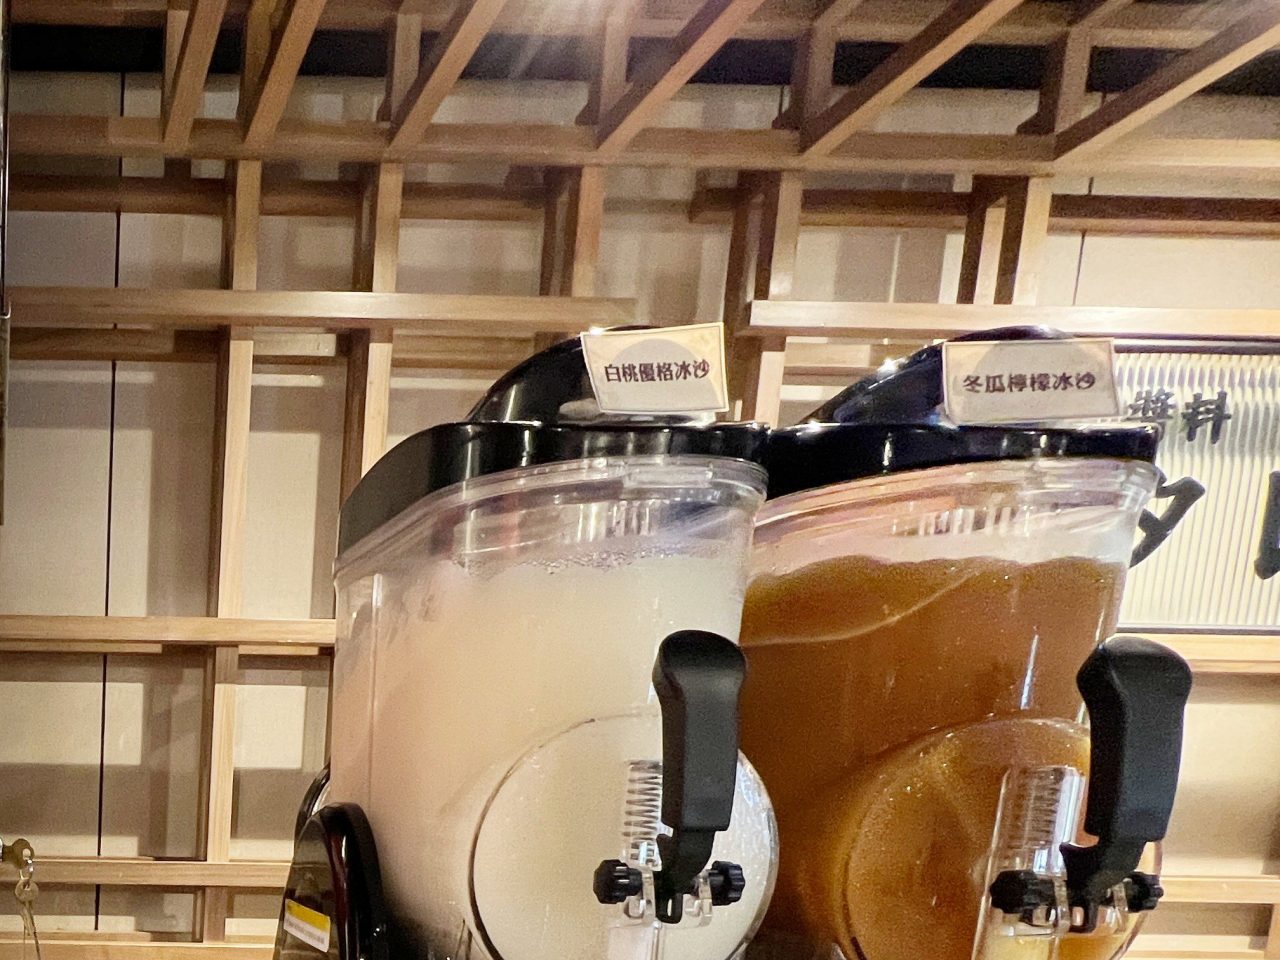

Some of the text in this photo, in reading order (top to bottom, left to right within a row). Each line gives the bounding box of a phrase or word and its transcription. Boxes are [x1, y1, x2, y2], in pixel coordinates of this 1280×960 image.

[604, 360, 710, 382] 白桃優格冰沙
[963, 372, 1096, 393] 冬瓜檸檬冰沙
